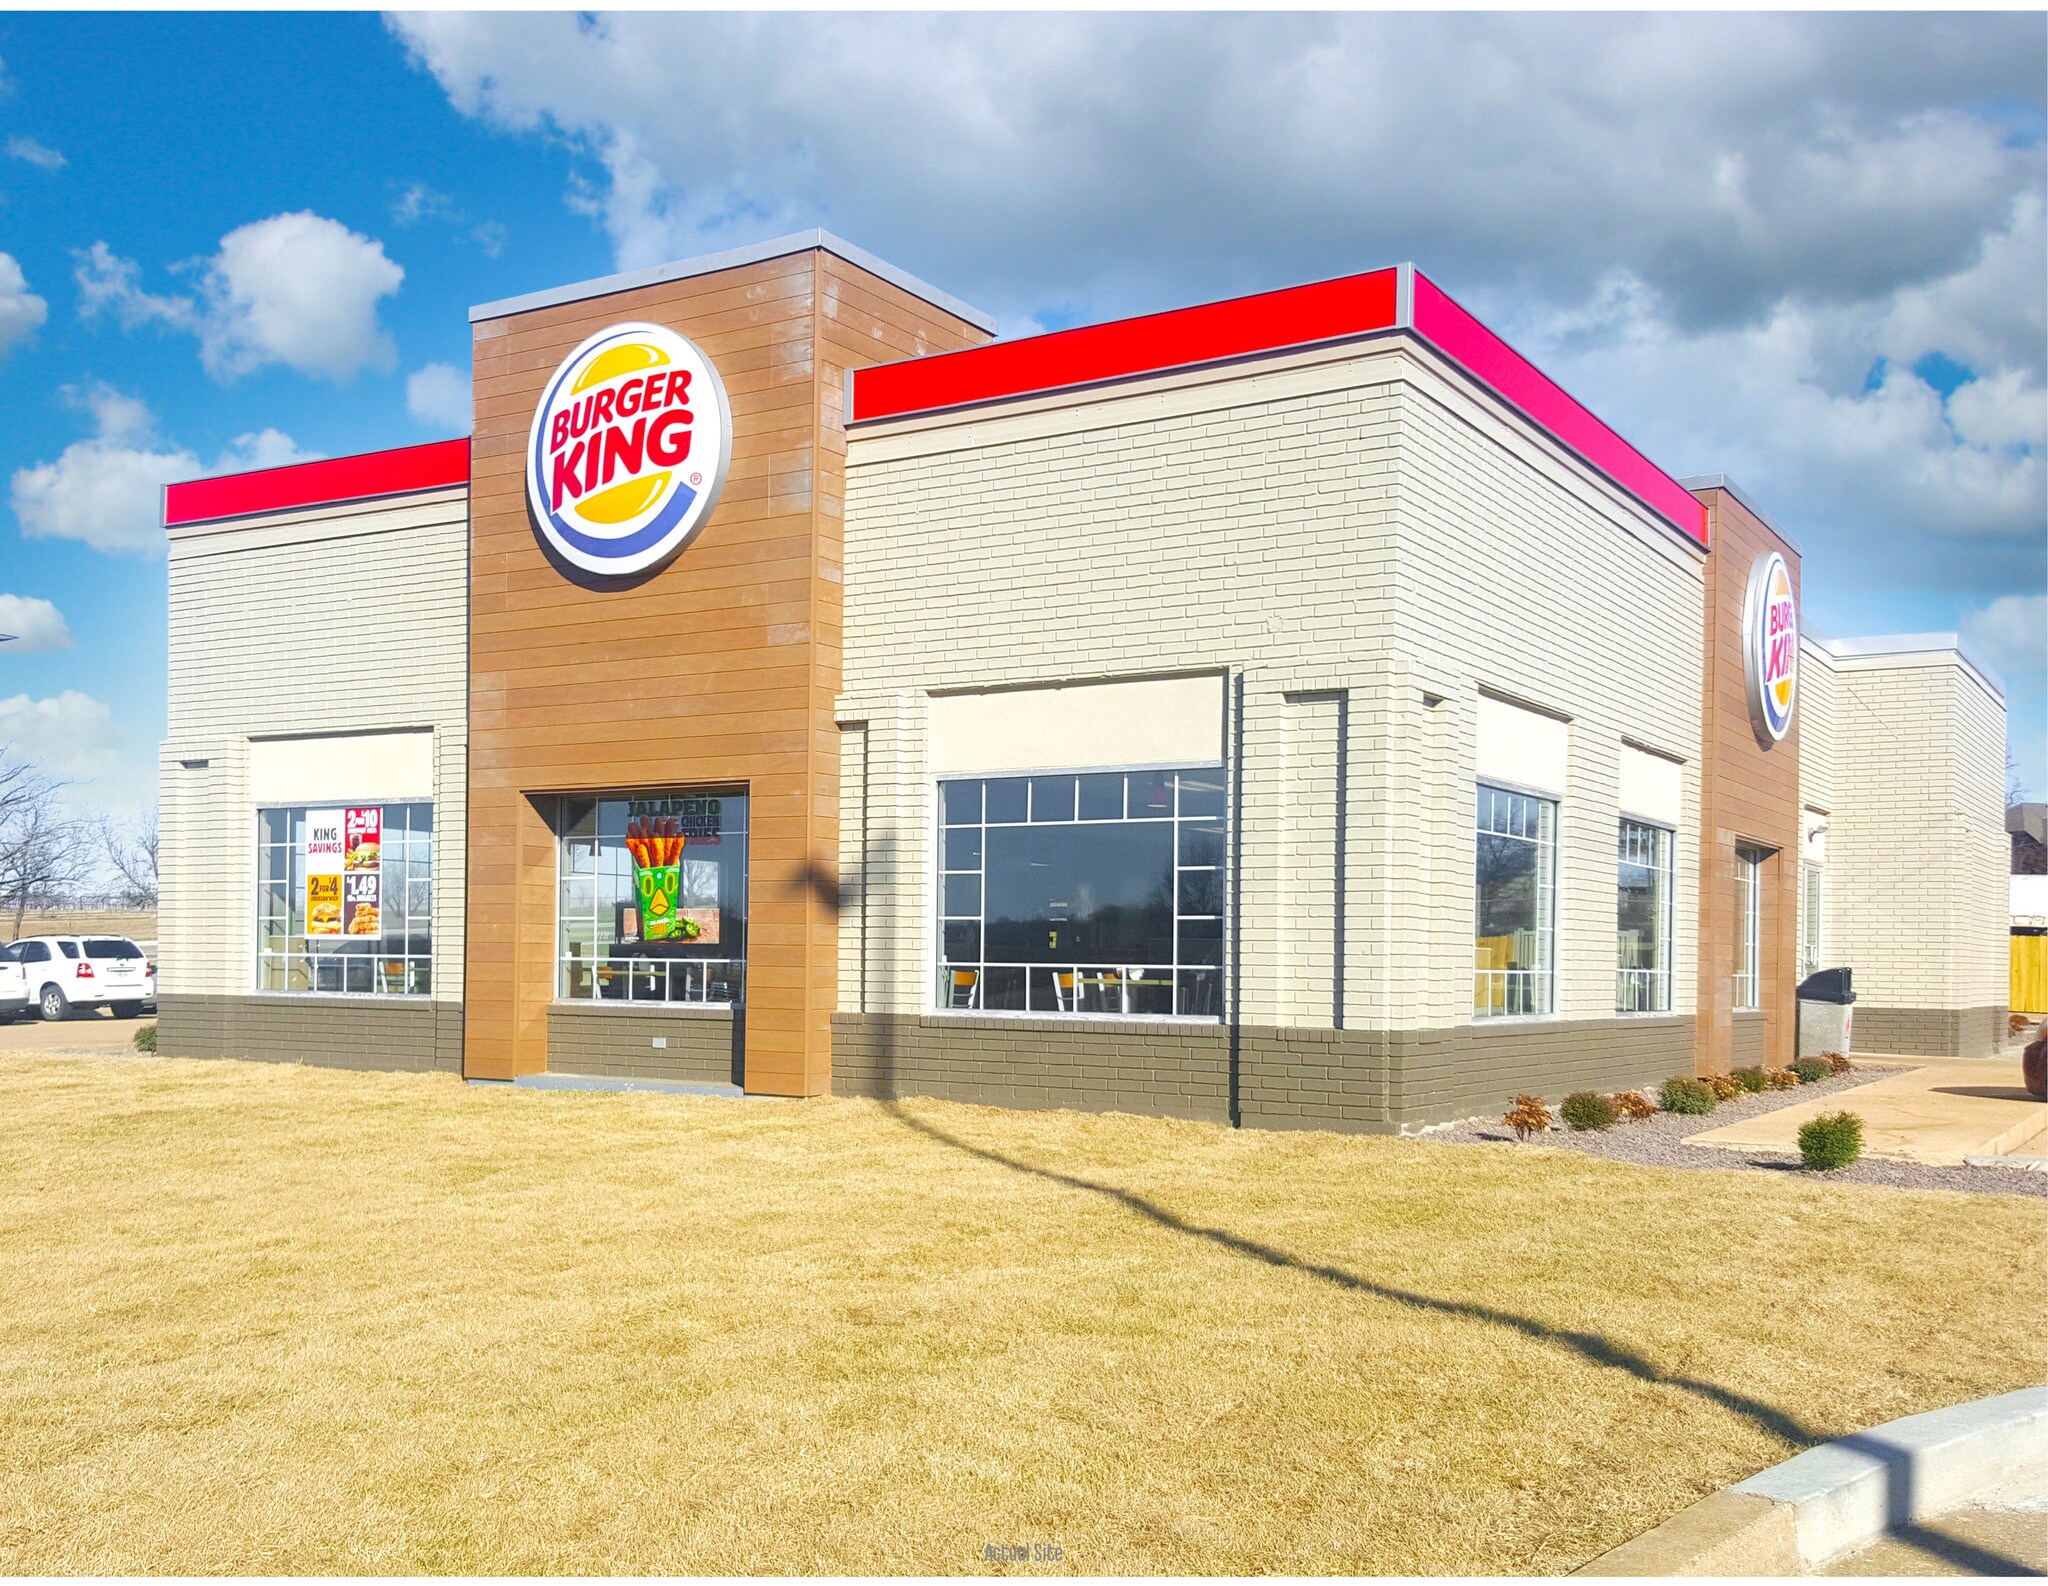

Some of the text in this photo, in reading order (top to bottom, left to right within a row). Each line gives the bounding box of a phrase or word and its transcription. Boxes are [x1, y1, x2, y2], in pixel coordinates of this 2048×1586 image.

[550, 369, 692, 455] BURGER
[552, 409, 694, 512] KING
[348, 810, 356, 828] 2
[681, 815, 720, 827] CHICKEN
[313, 828, 337, 841] KING
[308, 842, 342, 853] SAVINGS
[311, 877, 319, 895] 2
[329, 876, 338, 895] $4
